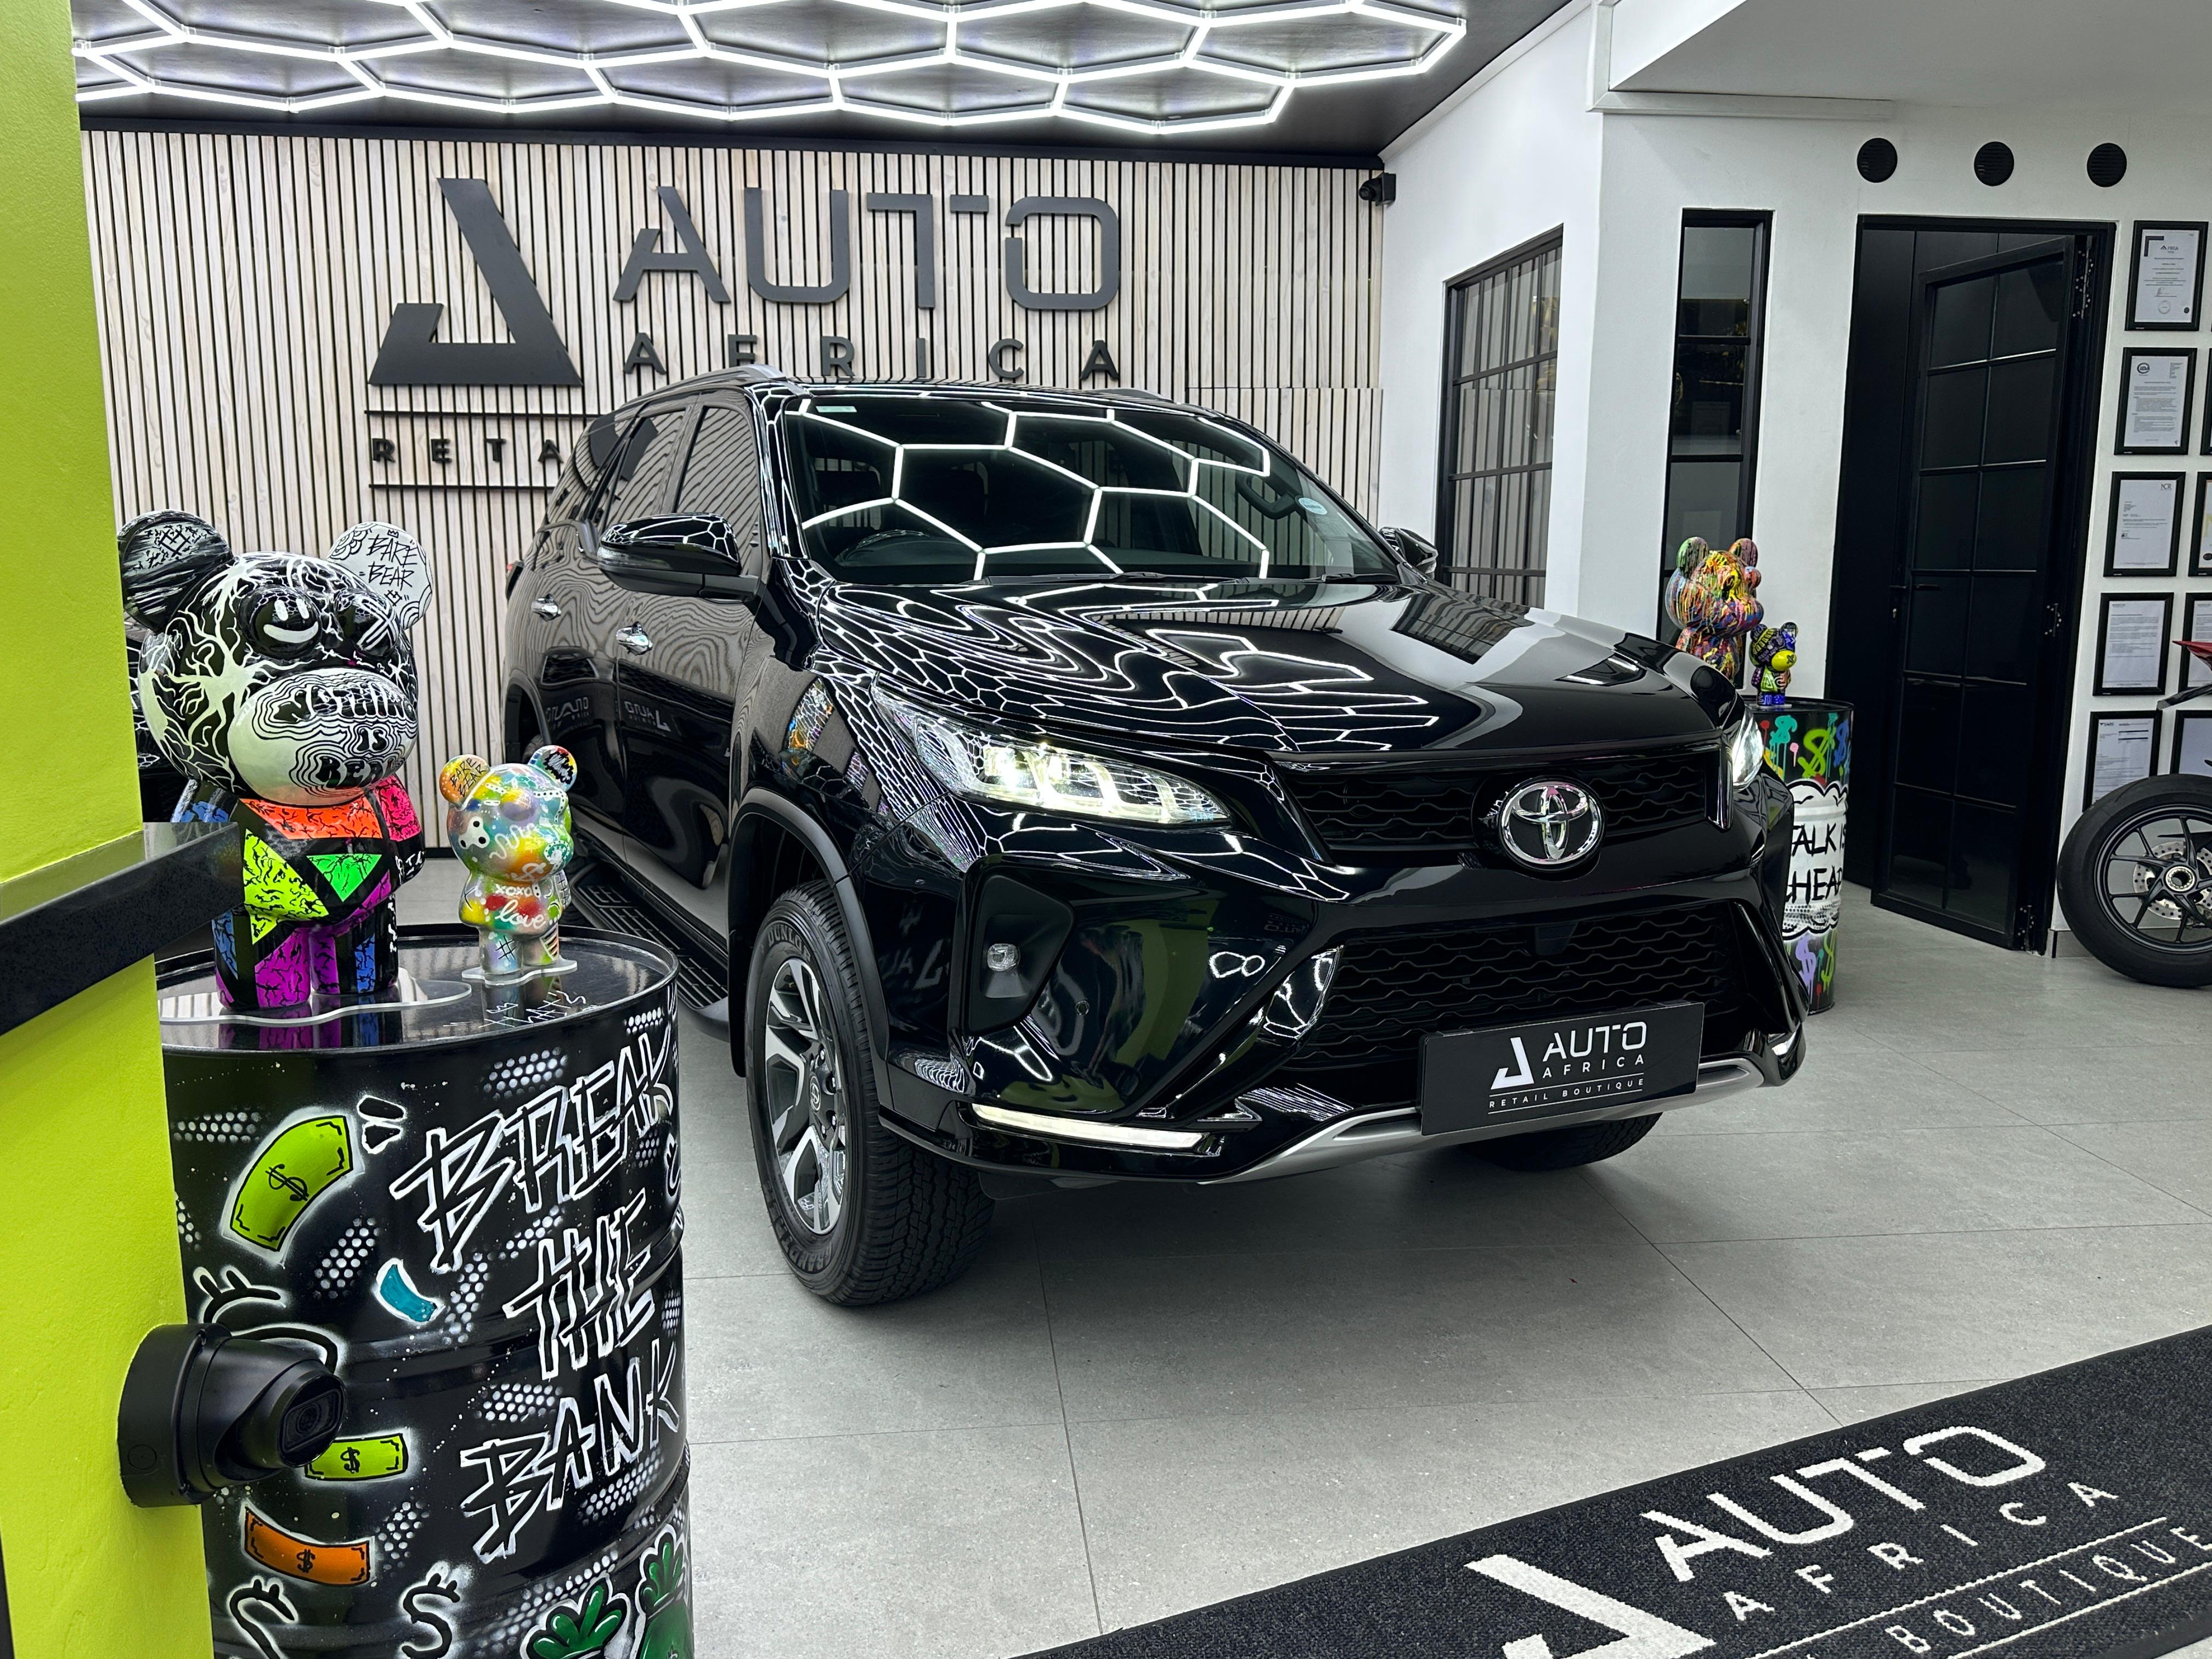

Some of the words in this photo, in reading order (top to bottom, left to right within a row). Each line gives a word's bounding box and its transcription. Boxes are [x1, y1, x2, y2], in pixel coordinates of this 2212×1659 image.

[613, 186, 1121, 311] AUTO
[622, 332, 1120, 381] AFRICA
[371, 438, 564, 464] RETA
[366, 534, 419, 568] BARE
[368, 561, 415, 591] BEAR
[355, 728, 388, 751] IS
[449, 757, 477, 789] BARE
[458, 763, 486, 798] BEAR
[1786, 865, 1842, 905] HEAP
[494, 899, 546, 929] love
[767, 923, 811, 963] DUNLOP
[1542, 1022, 1647, 1063] AUTO
[1542, 1054, 1645, 1079] AFRICA
[1488, 1092, 1549, 1108] RETAIL
[1562, 1077, 1644, 1098] BOUTIQUE
[389, 1024, 674, 1274] BREAK
[501, 1187, 657, 1382] THE
[460, 1339, 679, 1564] BANK
[1639, 1424, 2049, 1584] AUTO
[1722, 1480, 2119, 1622] AFRICA
[1884, 1526, 2212, 1654] BOUTIQUE
